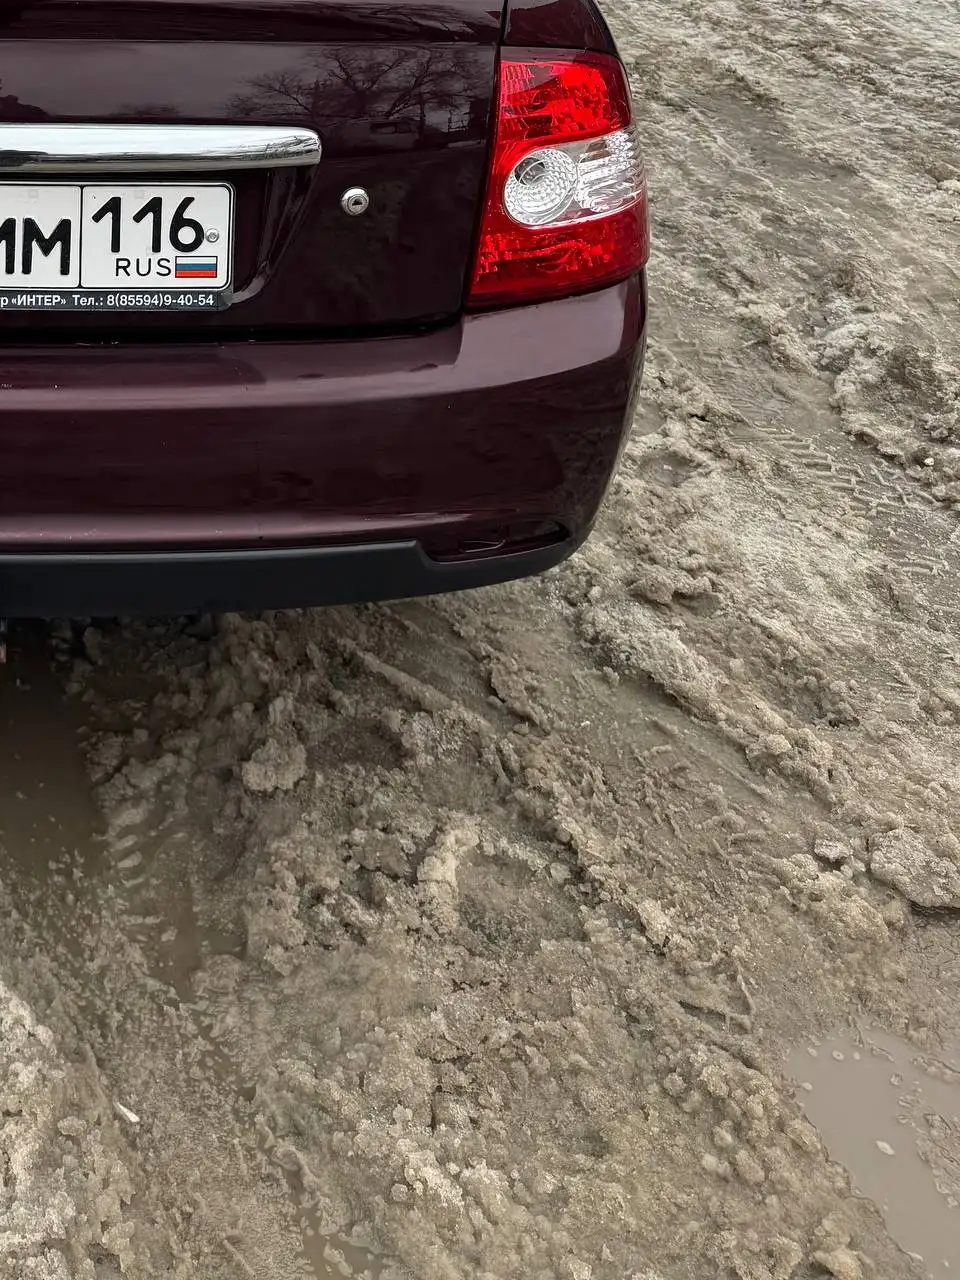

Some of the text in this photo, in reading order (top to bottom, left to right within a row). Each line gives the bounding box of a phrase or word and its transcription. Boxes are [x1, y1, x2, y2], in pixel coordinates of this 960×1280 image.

[92, 197, 205, 253] 116
[115, 258, 172, 277] RUS
[11, 294, 67, 306] «ИНТЕР»
[72, 294, 104, 306] Тел.:
[106, 293, 215, 307] 8(85594)9-40-54
